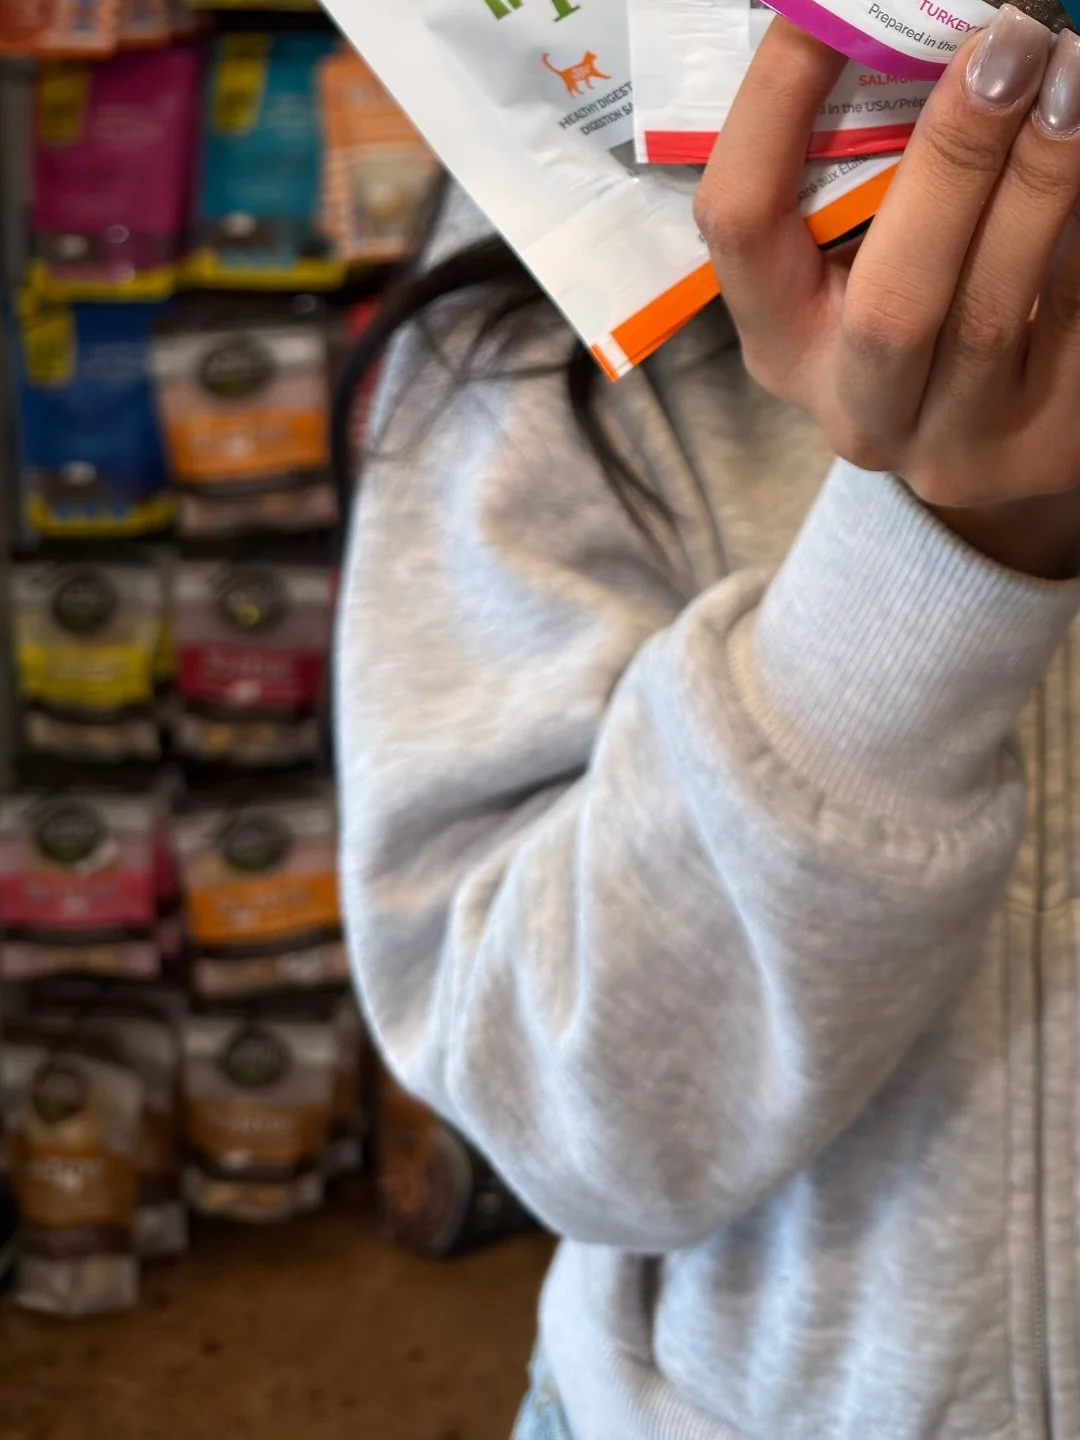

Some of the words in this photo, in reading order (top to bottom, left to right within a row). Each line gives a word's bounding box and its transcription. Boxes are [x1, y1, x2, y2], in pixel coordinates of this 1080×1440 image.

[868, 3, 926, 42] Prepared
[924, 35, 936, 48] in
[937, 37, 957, 52] the
[858, 75, 916, 87] SALM
[558, 97, 601, 130] HEALTHY
[827, 103, 840, 114] in
[841, 102, 863, 114] the
[580, 108, 623, 136] DIGESTION
[819, 171, 840, 189] aux
